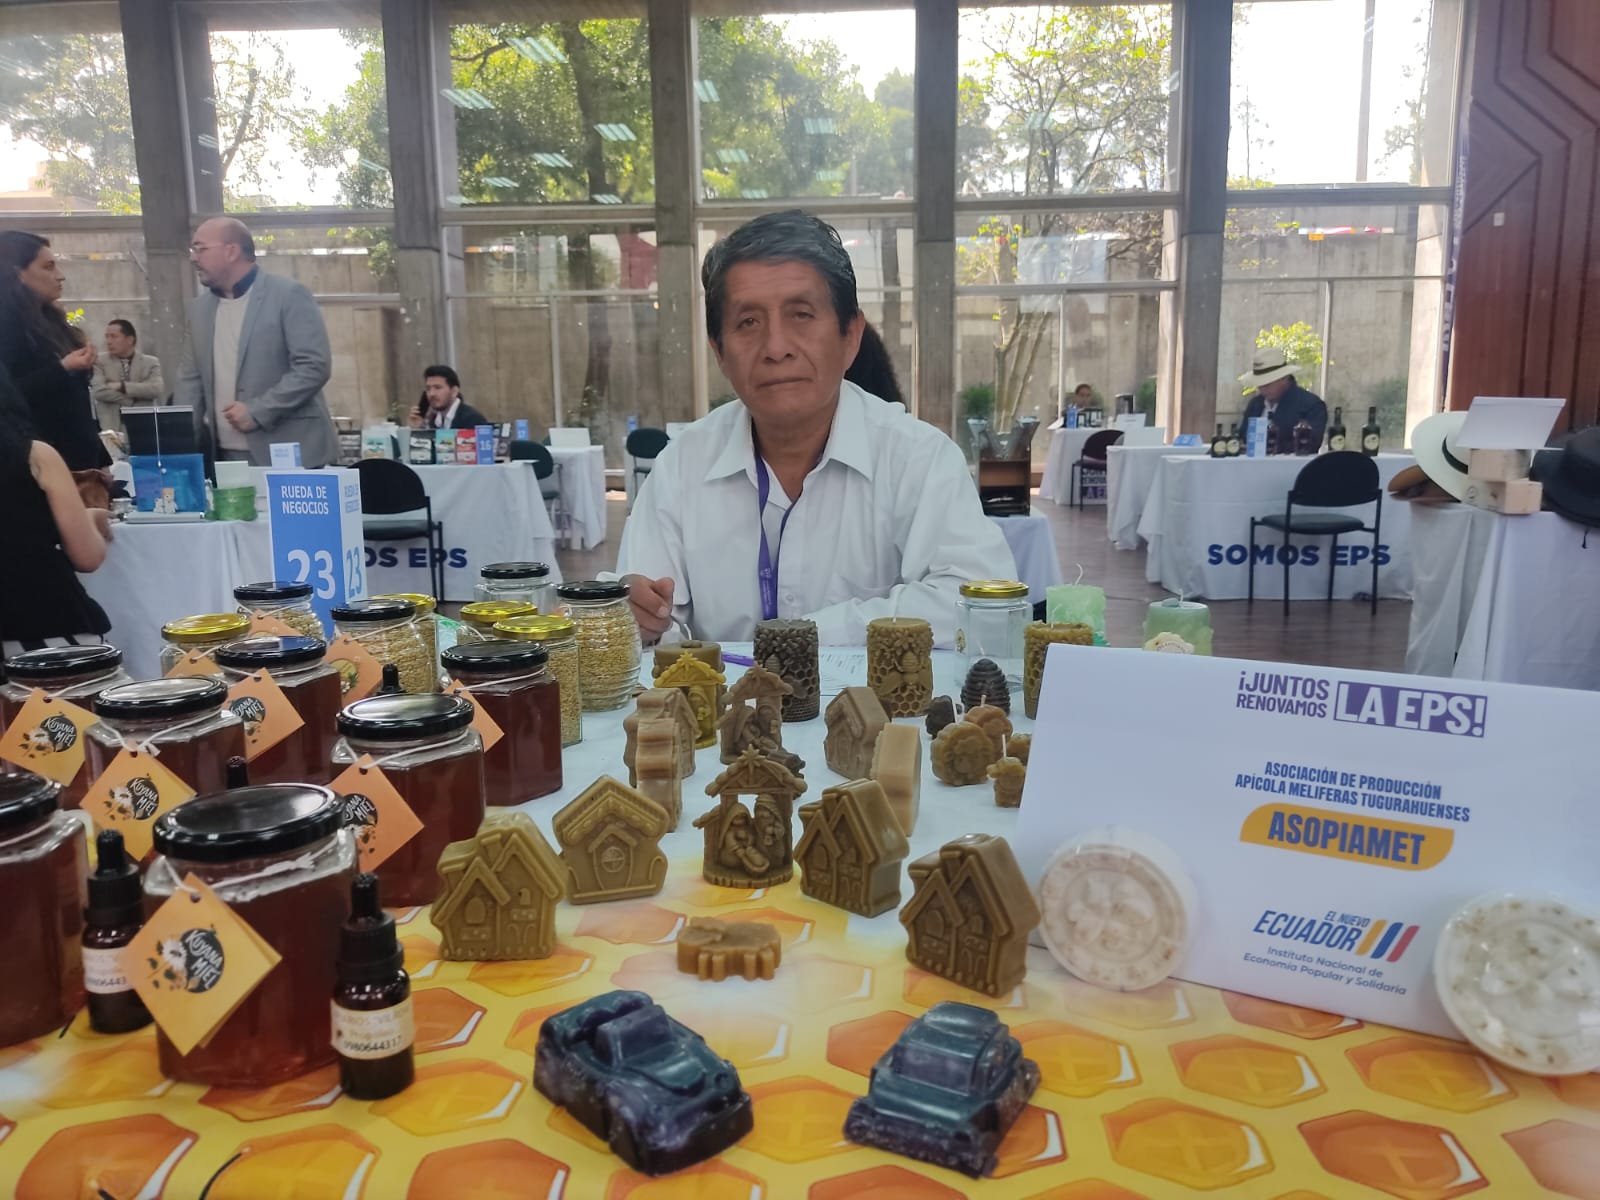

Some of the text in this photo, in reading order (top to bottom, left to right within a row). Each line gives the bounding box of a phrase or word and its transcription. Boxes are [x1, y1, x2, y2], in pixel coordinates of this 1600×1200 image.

[281, 485, 314, 499] RUEDA
[316, 486, 328, 499] DE
[282, 501, 329, 515] NEGOCIOS
[409, 548, 467, 568] EPS
[1208, 544, 1391, 566] SOMOS EPS
[287, 549, 336, 600] 23
[346, 547, 363, 599] 23
[1239, 670, 1330, 701] ¡JUNTOS
[245, 699, 265, 720] MIEL
[1236, 693, 1328, 718] RENOVAMOS
[1336, 683, 1486, 737] LA EPS!
[44, 717, 75, 735] KUYANA
[55, 731, 77, 747] MIEL
[130, 778, 158, 802] KUYANA
[1264, 761, 1442, 800] ASOCIACIÓN DE PRODUCCIÓN
[136, 795, 159, 816] MIEL
[354, 797, 376, 822] MIEL
[1235, 773, 1470, 822] APÍCOLA MELIFERAS TUGURAHUENSES
[1268, 811, 1425, 865] ASOPIAMET
[1253, 910, 1363, 951] ECUADOR
[1324, 910, 1371, 928] EL NUEVO
[185, 929, 224, 968] KUYANA
[1267, 946, 1384, 978] Instituto Nacional de
[190, 957, 221, 989] MIEL
[1300, 965, 1344, 983] Popular
[1345, 975, 1354, 985] y
[1355, 977, 1408, 996] Solidaria
